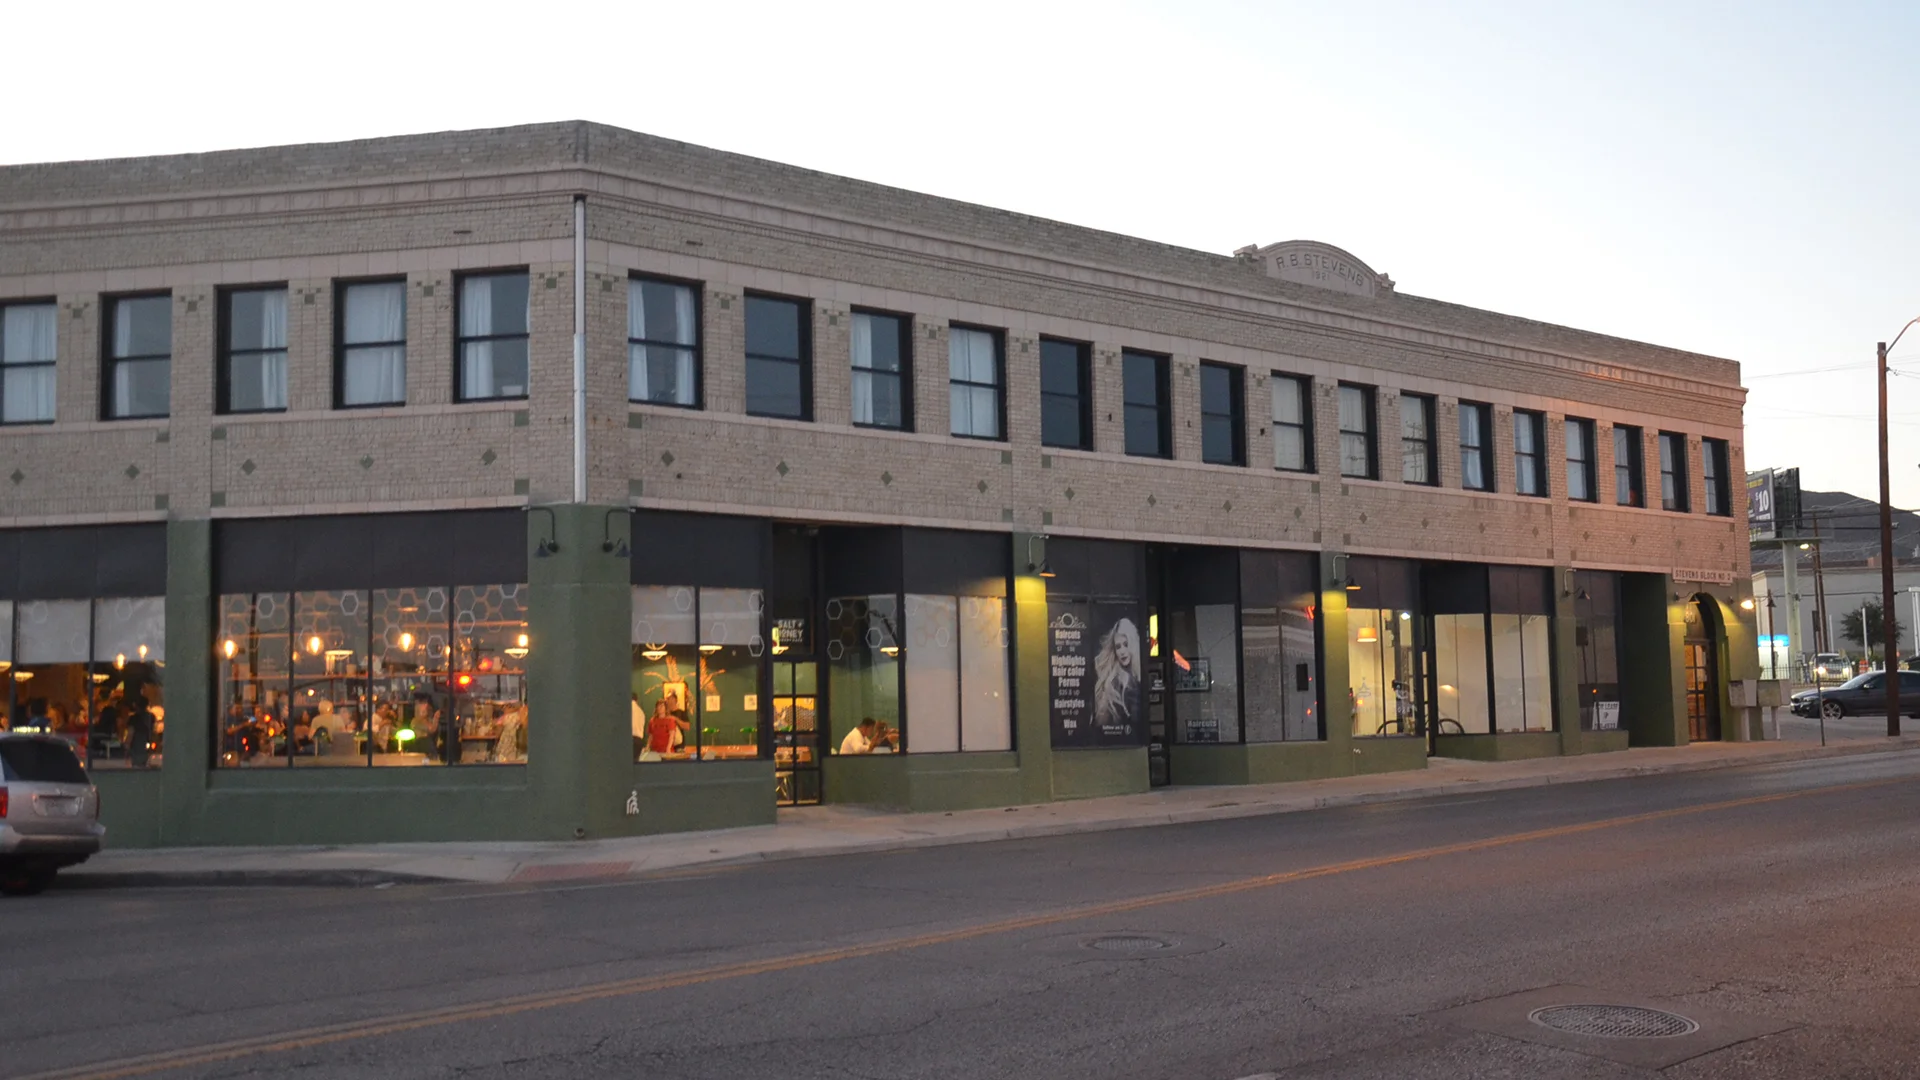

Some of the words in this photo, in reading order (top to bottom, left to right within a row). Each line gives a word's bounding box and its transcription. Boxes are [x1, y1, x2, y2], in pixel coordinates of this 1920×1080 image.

[1304, 253, 1364, 287] STEVENS
[1756, 490, 1769, 512] $10
[1676, 570, 1698, 579] STEVENS
[778, 620, 796, 628] SALT
[1055, 629, 1081, 639] Haircuts
[1051, 655, 1086, 666] Highlights
[1052, 666, 1067, 677] Hair
[1067, 666, 1086, 677] color
[1058, 677, 1080, 688] Perms
[1054, 699, 1085, 709] Hairstyles
[1063, 719, 1077, 729] Wax
